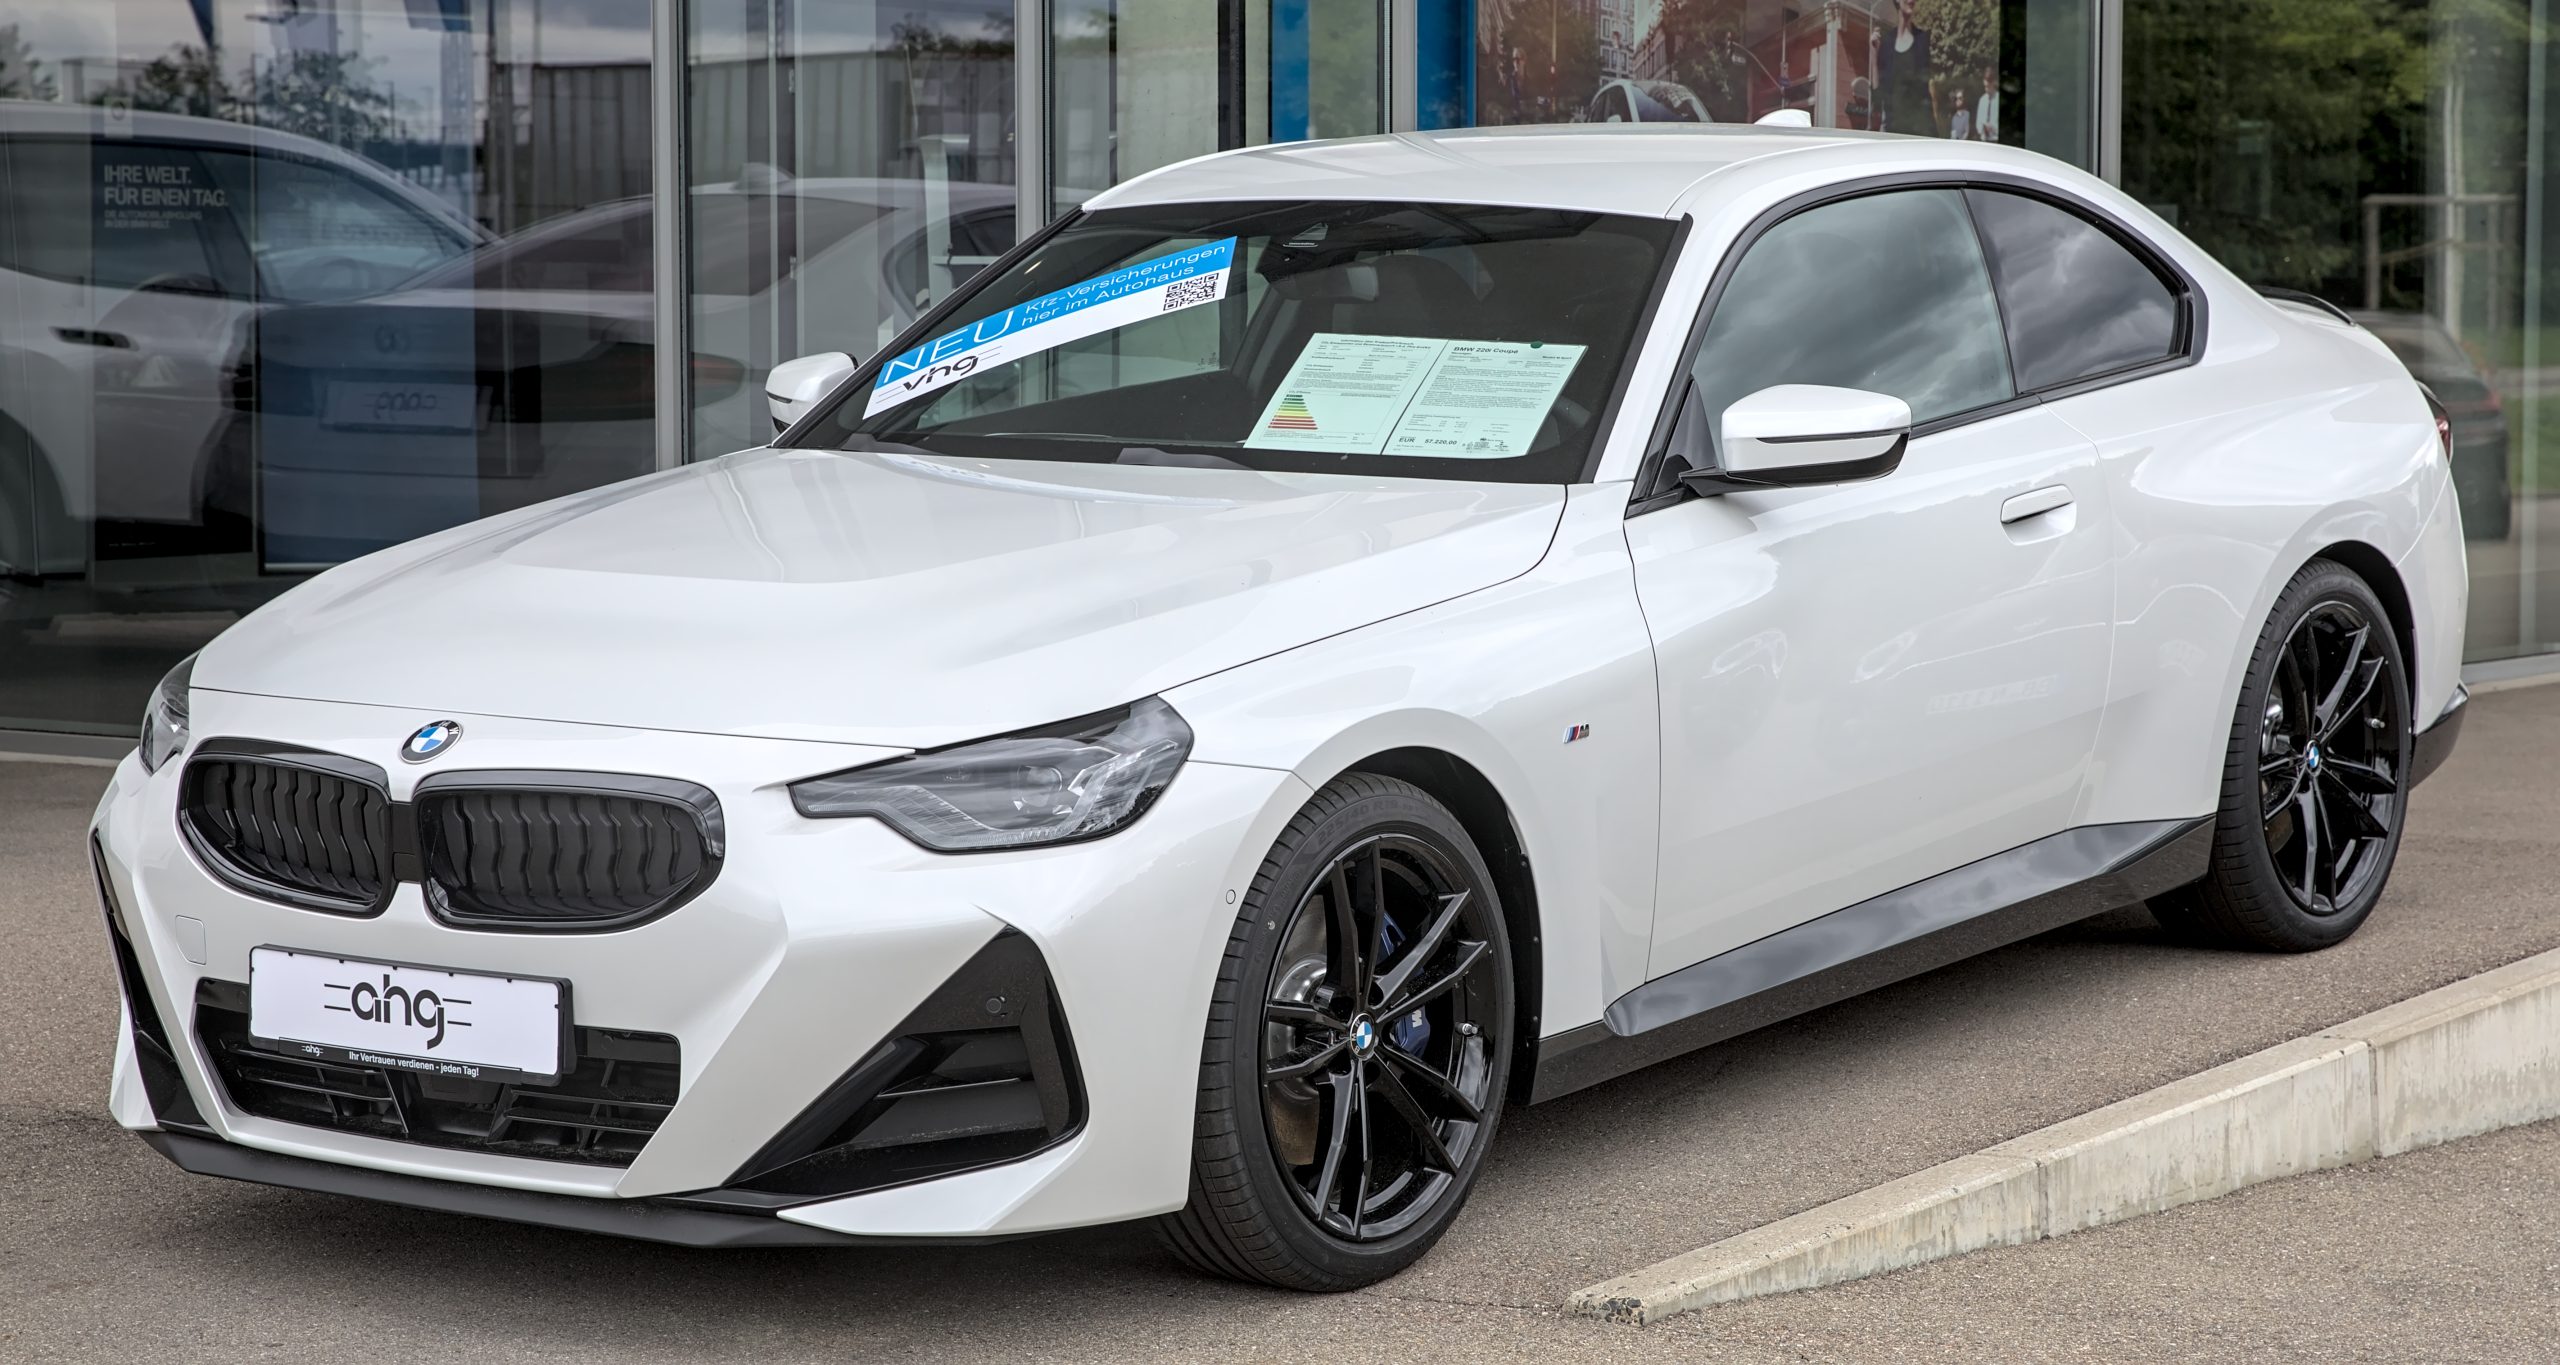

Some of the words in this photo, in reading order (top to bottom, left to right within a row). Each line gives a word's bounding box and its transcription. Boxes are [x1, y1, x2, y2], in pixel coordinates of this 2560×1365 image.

[104, 165, 143, 183] IHRE
[145, 166, 193, 184] WELT.
[104, 184, 138, 205] FÜR
[141, 187, 190, 206] EINEN
[192, 188, 229, 207] TAG.
[1021, 308, 1058, 327] hier
[1065, 297, 1088, 311] im
[1095, 266, 1194, 301] Autohaus
[1025, 245, 1226, 315] Kfz-Versicherungen
[884, 310, 1014, 384] NEU
[903, 355, 979, 391] vhg
[351, 974, 445, 1050] ahg
[349, 1051, 359, 1061] Ihr
[360, 1053, 396, 1066] Vertrauen
[397, 1058, 435, 1071] verdienen
[440, 1062, 462, 1074] jeden
[462, 1065, 480, 1078] Tag!
